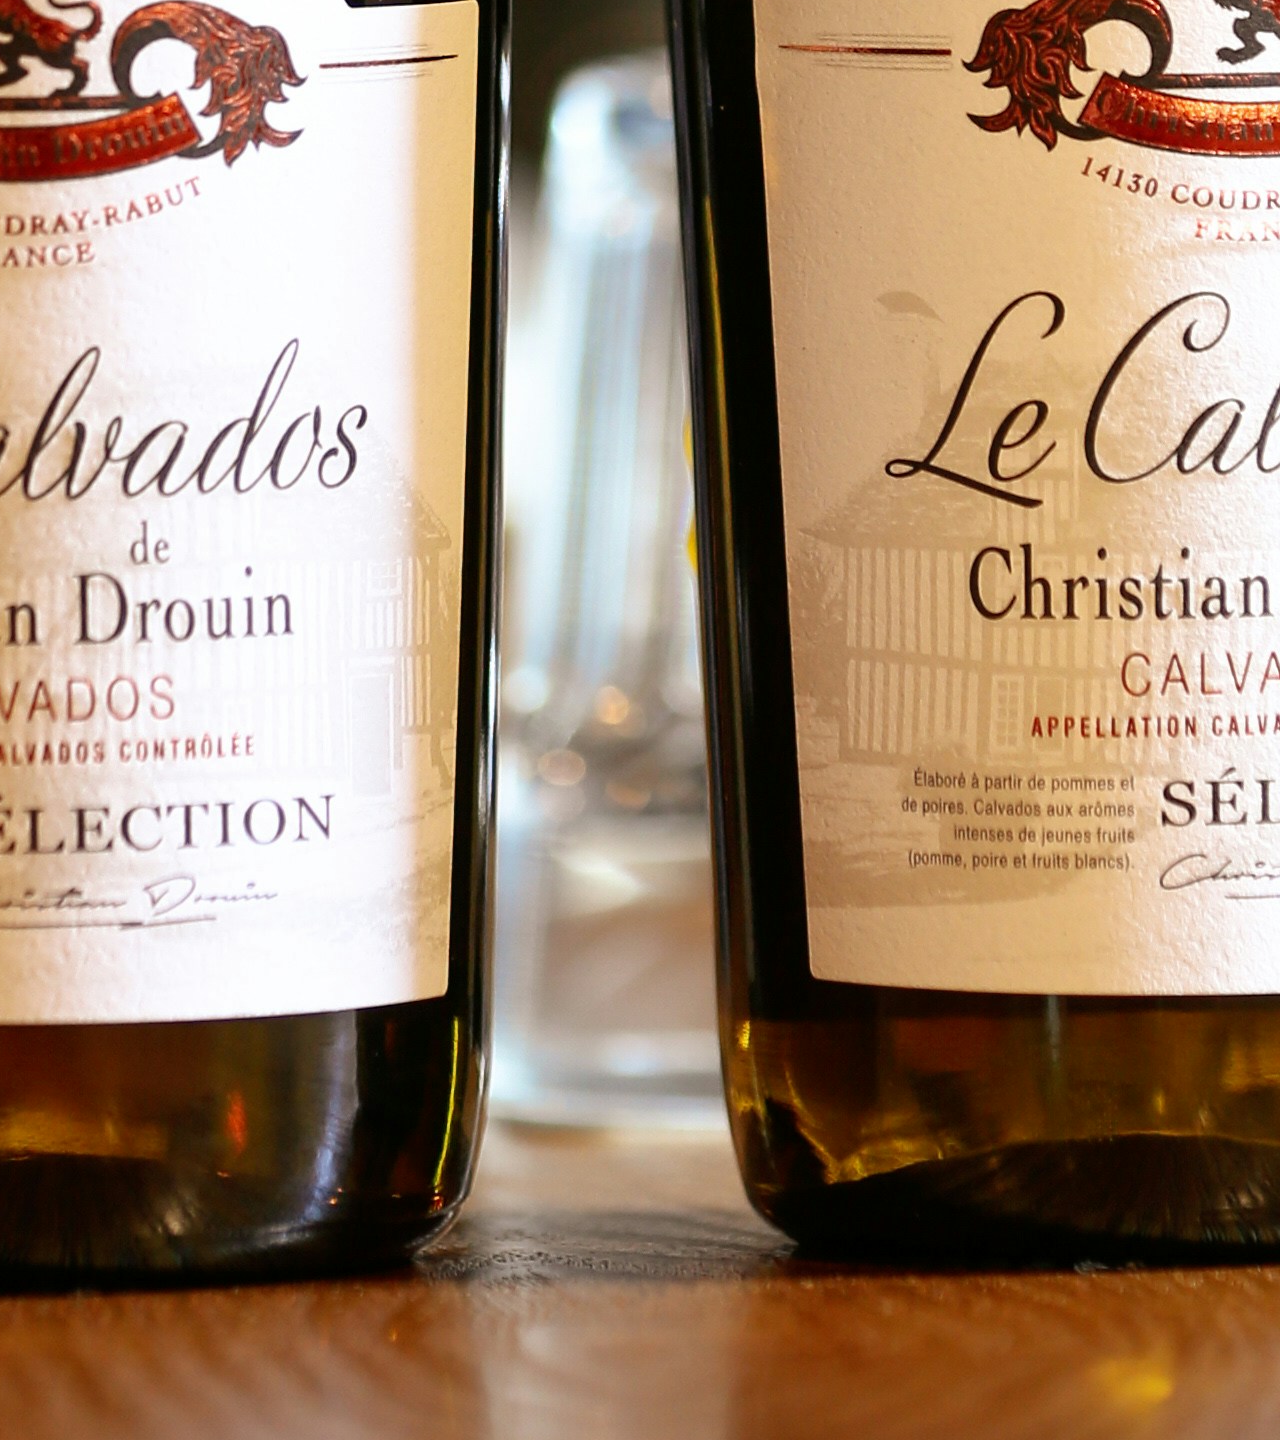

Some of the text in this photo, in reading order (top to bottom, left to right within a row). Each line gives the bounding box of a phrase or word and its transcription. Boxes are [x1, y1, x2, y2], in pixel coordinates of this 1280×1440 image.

[1096, 88, 1276, 144] Christian
[1080, 156, 1159, 199] 14130
[883, 290, 1066, 509] Le
[129, 520, 171, 566] de
[967, 542, 1274, 623] Christian
[74, 566, 295, 647] Drouin
[1030, 715, 1198, 739] APPELLATION
[119, 731, 256, 761] CONTRÔLÉE
[914, 768, 1135, 794] Élaboré à partir de pommes et
[901, 797, 1135, 817] de poires. Calvados aux arômes
[954, 825, 1135, 846] intenses de jeunes fruits
[908, 850, 967, 869] (pomme,
[972, 852, 1007, 870] poire
[1013, 854, 1026, 867] et
[1032, 853, 1069, 869] fruits
